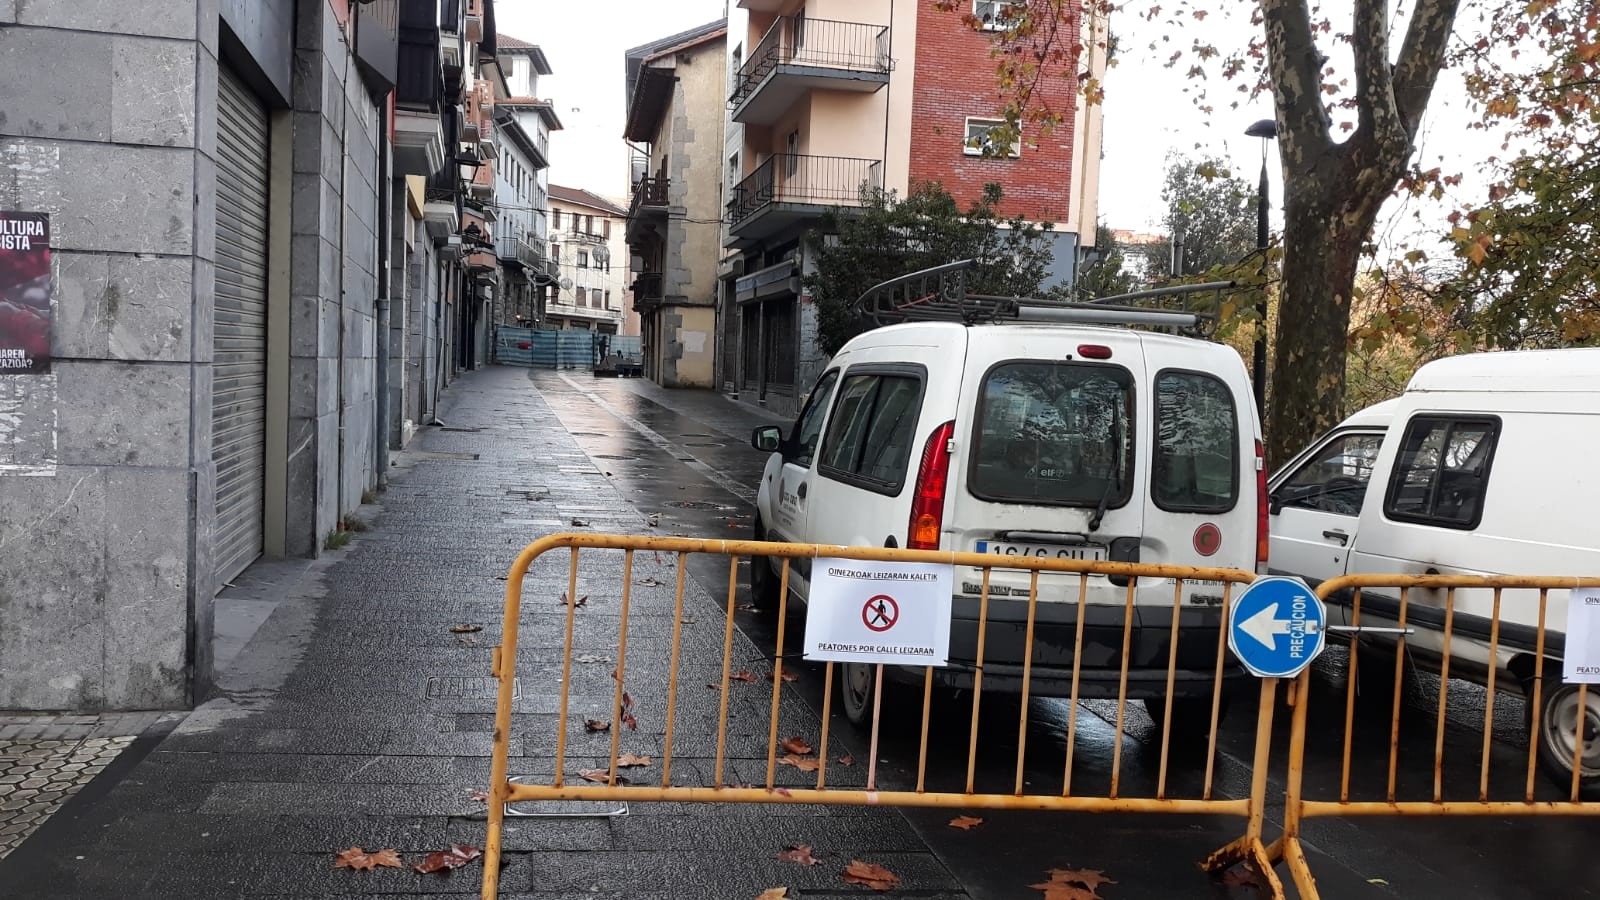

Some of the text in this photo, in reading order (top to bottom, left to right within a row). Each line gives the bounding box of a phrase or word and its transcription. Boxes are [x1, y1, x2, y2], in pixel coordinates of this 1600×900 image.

[0, 219, 44, 236] LTURA
[0, 234, 31, 250] ISTA
[0, 349, 25, 359] AREN
[828, 567, 872, 579] OINEZKOAK
[873, 572, 909, 580] LEIZARAN
[1291, 595, 1306, 658] PRECAUCION
[818, 642, 935, 655] PEATONES POR CALLE LEIZARAN
